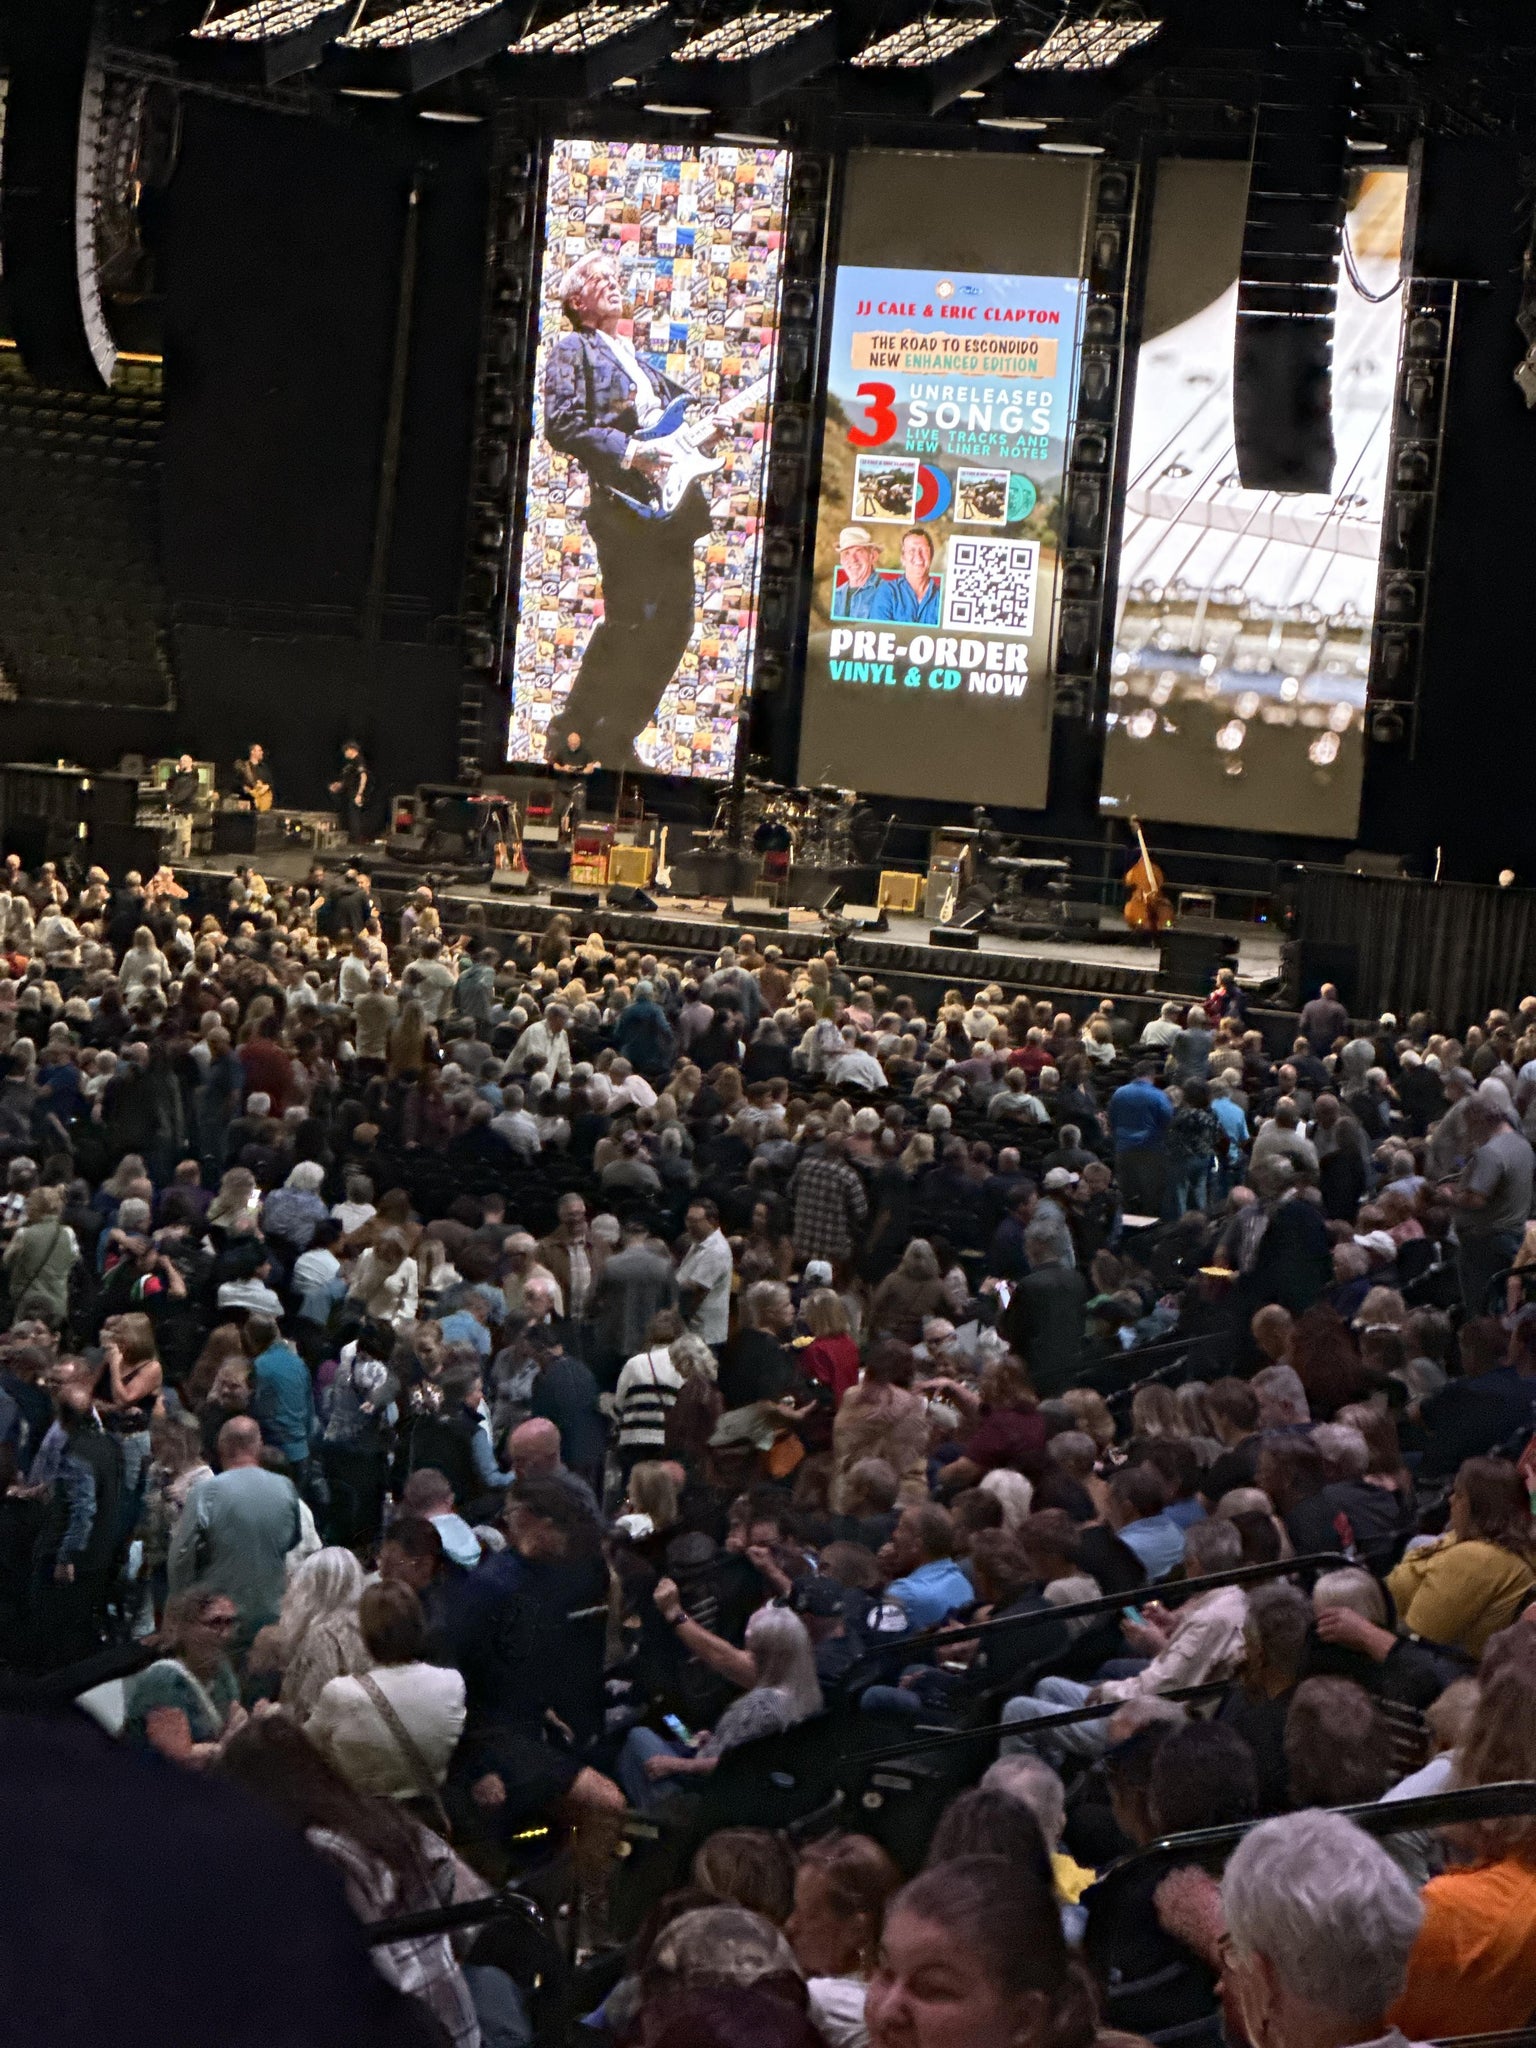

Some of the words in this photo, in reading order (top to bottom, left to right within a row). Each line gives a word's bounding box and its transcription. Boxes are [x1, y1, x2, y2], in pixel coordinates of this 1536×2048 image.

[856, 300, 871, 316] JJ
[877, 301, 916, 316] CALE
[923, 304, 934, 318] &
[941, 304, 978, 320] ERIC
[984, 306, 1060, 324] CLAPTON
[871, 335, 896, 350] THE
[900, 336, 938, 351] ROAD
[942, 338, 960, 352] TO
[965, 339, 1039, 355] ESCONDIDO
[869, 352, 900, 367] NEW
[905, 353, 978, 370] ENHANCED
[983, 356, 1038, 372] EDITION
[910, 383, 1053, 407] UNRELEASED
[847, 381, 898, 447] 3
[907, 400, 1051, 436] SONGS
[906, 427, 939, 441] LIVE
[949, 430, 1007, 445] TRACKS
[1016, 435, 1049, 448] AND
[905, 440, 938, 453] NEW
[947, 442, 991, 456] LINER
[1000, 446, 1048, 460] NOTES
[829, 629, 1029, 673] PRE-ORDER
[829, 660, 896, 685] VINYL
[904, 666, 921, 687] &
[928, 668, 962, 690] CD
[968, 671, 1028, 697] NOW
